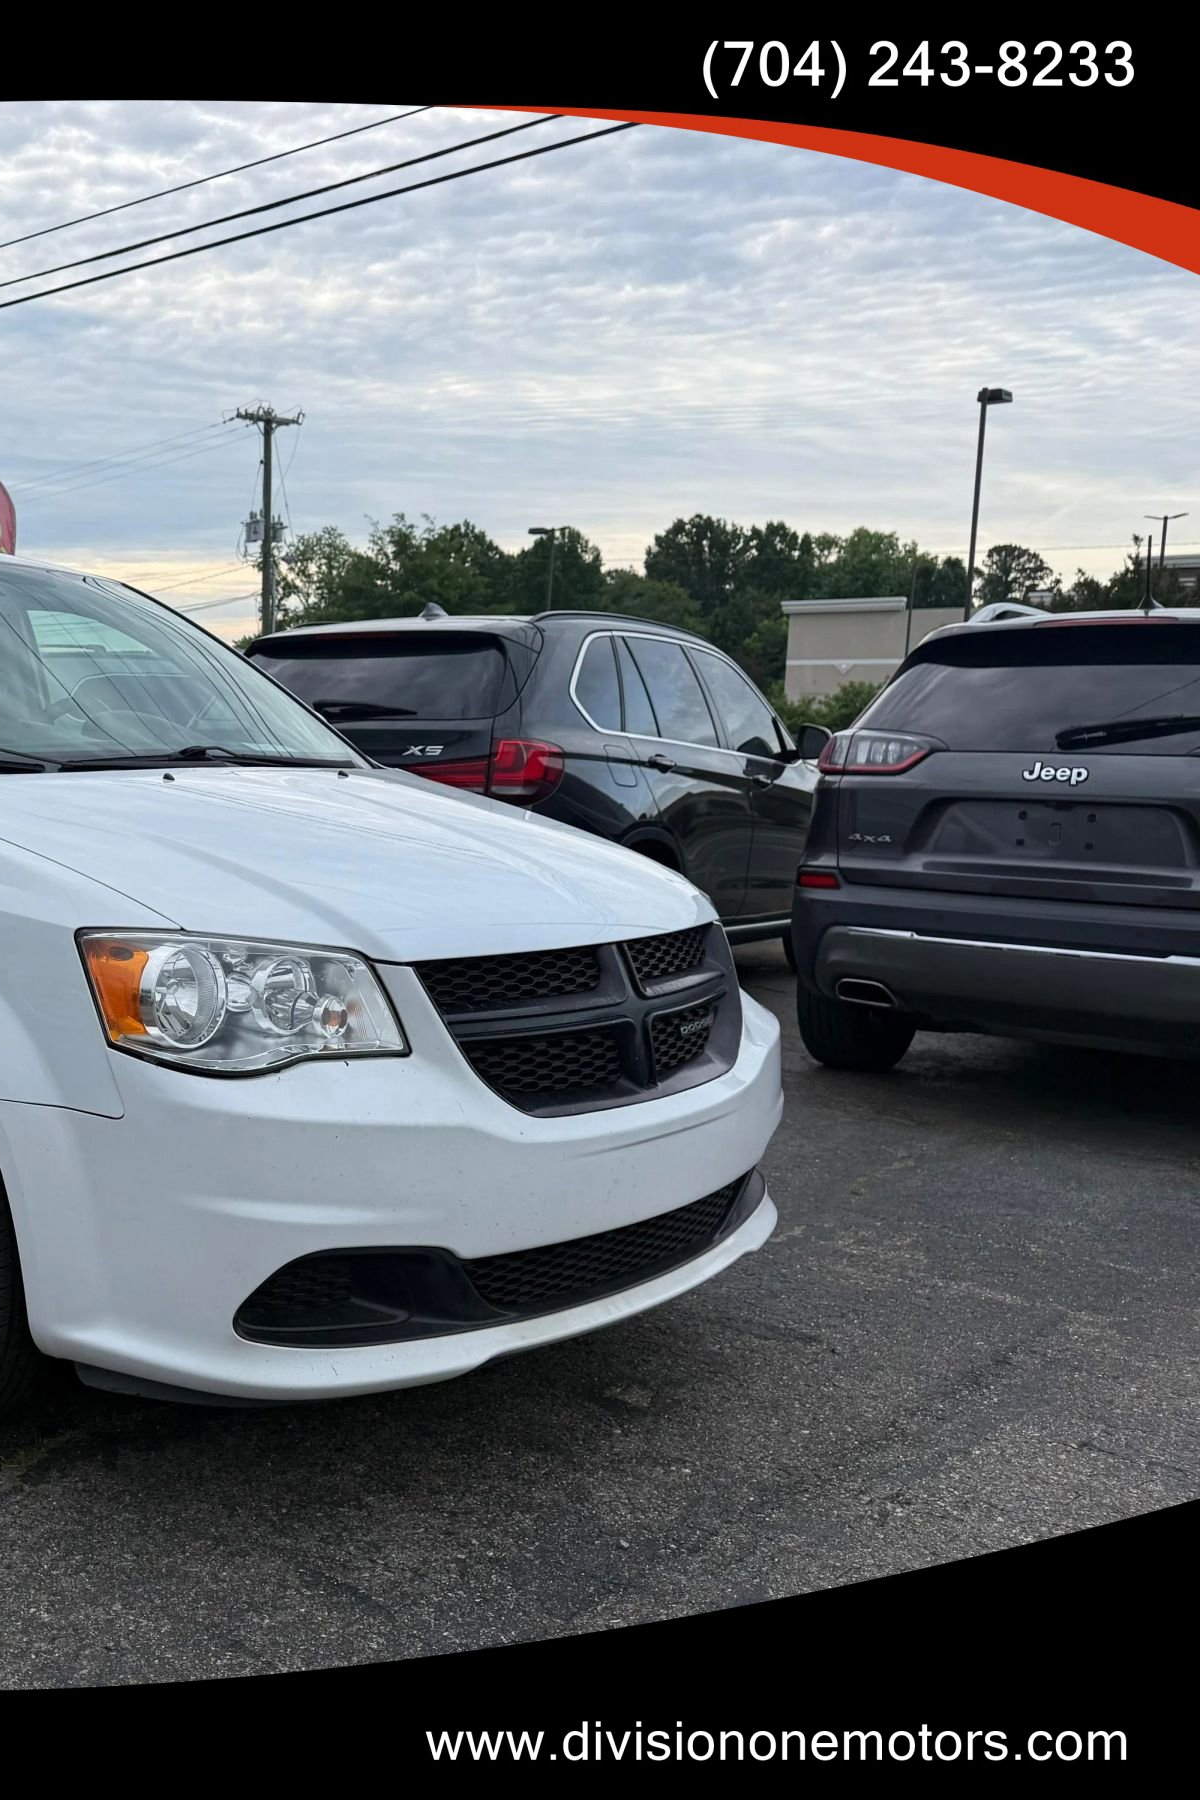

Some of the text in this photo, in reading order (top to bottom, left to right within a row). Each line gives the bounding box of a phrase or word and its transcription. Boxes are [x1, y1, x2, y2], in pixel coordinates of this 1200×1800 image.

[401, 745, 444, 756] X5
[1022, 761, 1089, 786] Jeep
[848, 833, 892, 843] 4x4
